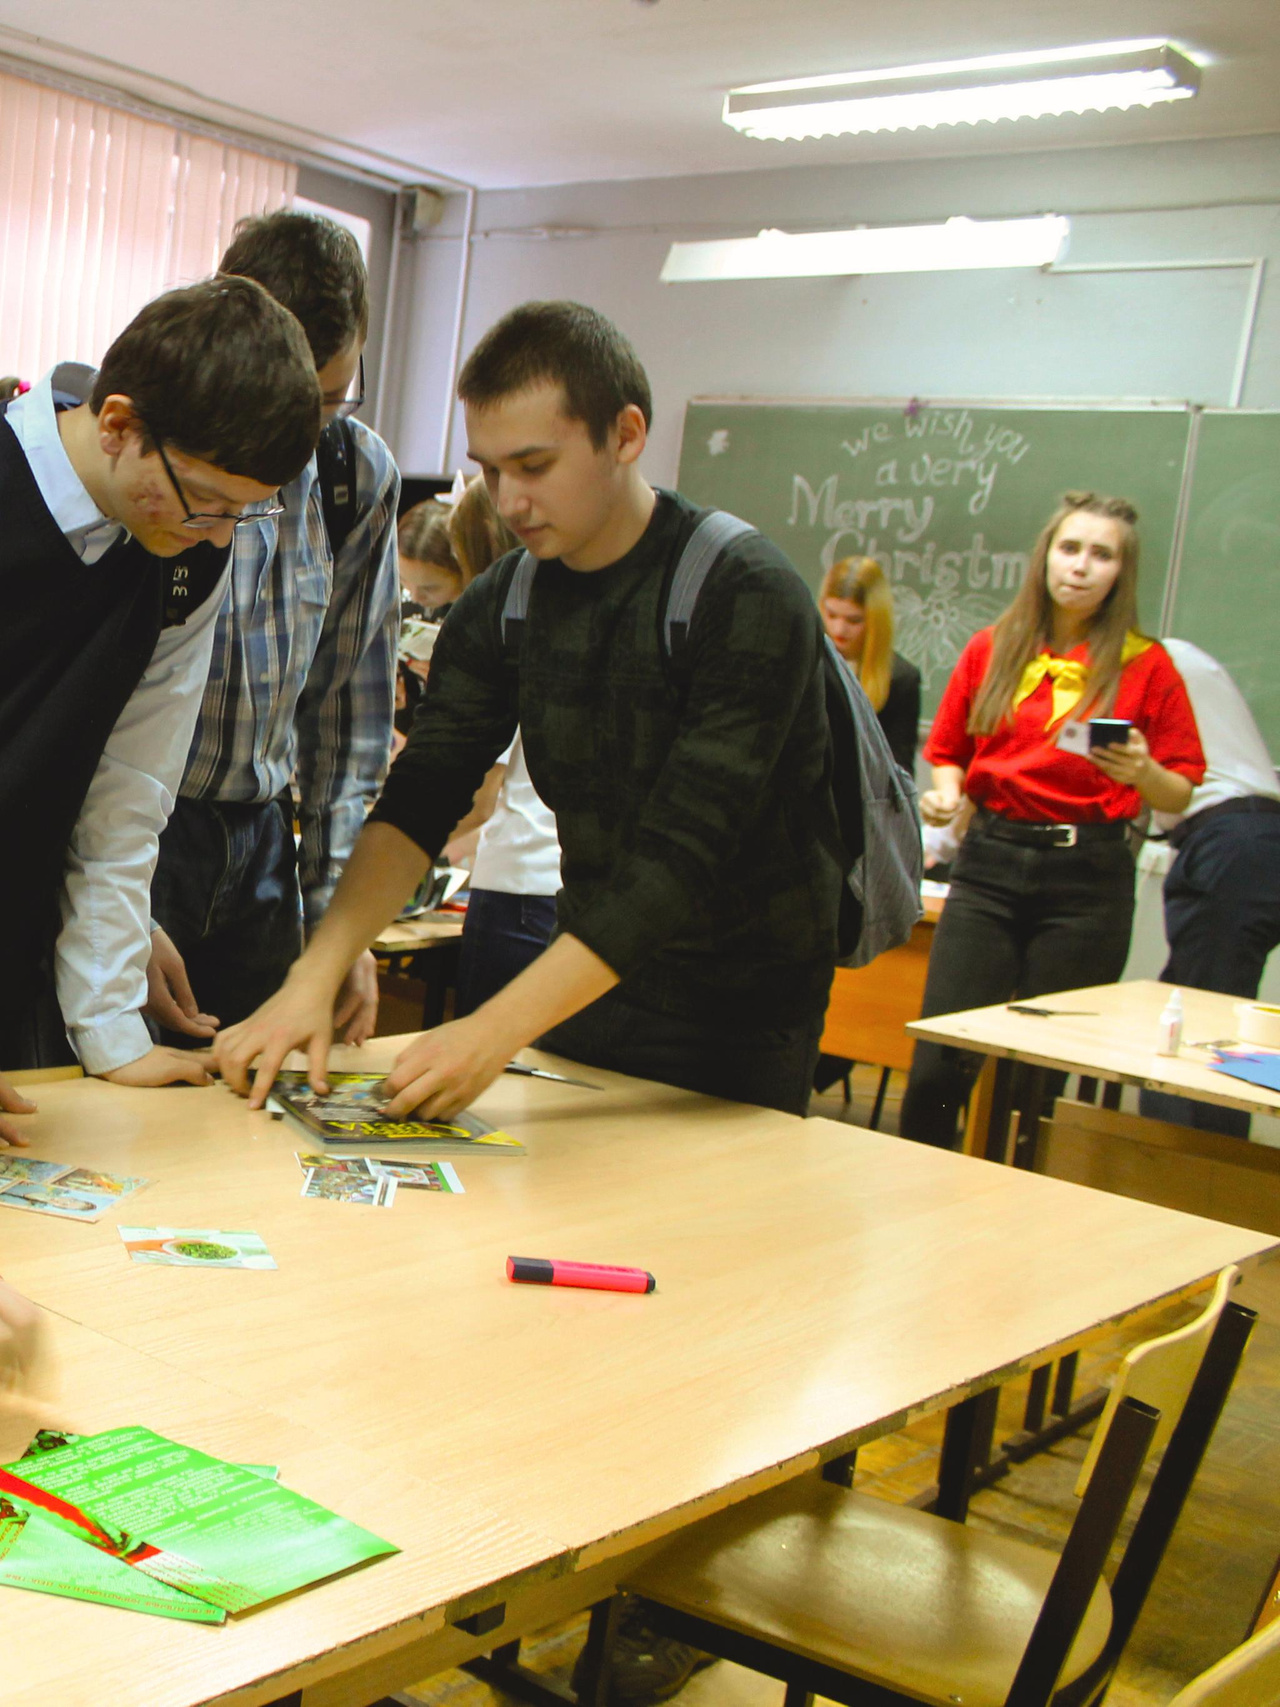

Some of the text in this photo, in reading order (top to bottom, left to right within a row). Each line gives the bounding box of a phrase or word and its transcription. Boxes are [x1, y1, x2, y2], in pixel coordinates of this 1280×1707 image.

[904, 410, 974, 455] wish
[972, 423, 1030, 464] you
[787, 474, 934, 543] Merry
[875, 453, 998, 515] a very
[820, 527, 1031, 590] Christm
